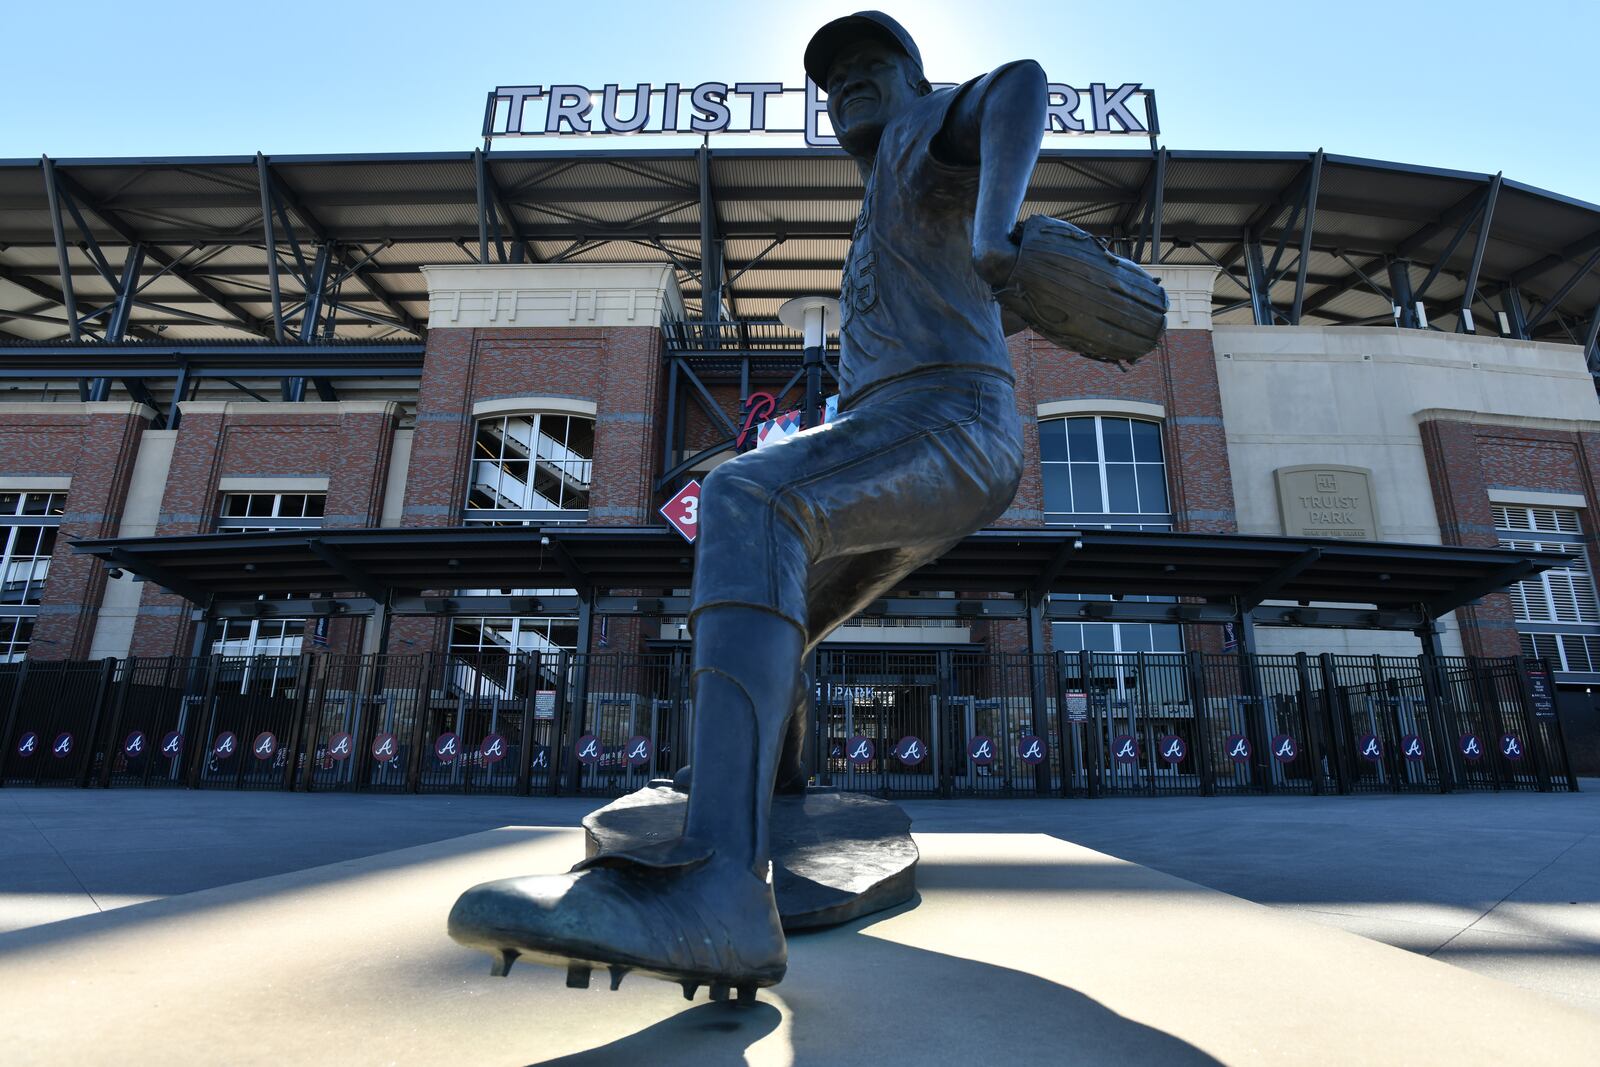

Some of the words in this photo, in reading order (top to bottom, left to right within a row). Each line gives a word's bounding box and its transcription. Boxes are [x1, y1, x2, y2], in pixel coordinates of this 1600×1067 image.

[496, 82, 783, 132] TRUIST
[679, 496, 699, 525] 3
[1300, 497, 1359, 509] TRUIST
[1309, 511, 1355, 524] PARK
[20, 736, 34, 751] A
[55, 737, 69, 752] A
[127, 736, 141, 751] A
[164, 736, 178, 751] A
[217, 736, 232, 752] A
[256, 737, 271, 753] A
[332, 737, 348, 753] A
[376, 738, 392, 754] A
[439, 738, 455, 754] A
[484, 739, 501, 756] A
[579, 740, 597, 757] A
[629, 741, 647, 758] A
[850, 741, 869, 758] A
[901, 741, 920, 758] A
[973, 741, 991, 757] A
[1023, 741, 1041, 758] A
[1117, 740, 1134, 757] A
[1164, 740, 1181, 756] A
[1230, 739, 1247, 756] A
[1276, 739, 1293, 756] A
[1363, 739, 1379, 755] A
[1406, 739, 1421, 755] A
[1464, 738, 1479, 753] A
[1504, 738, 1519, 754] A
